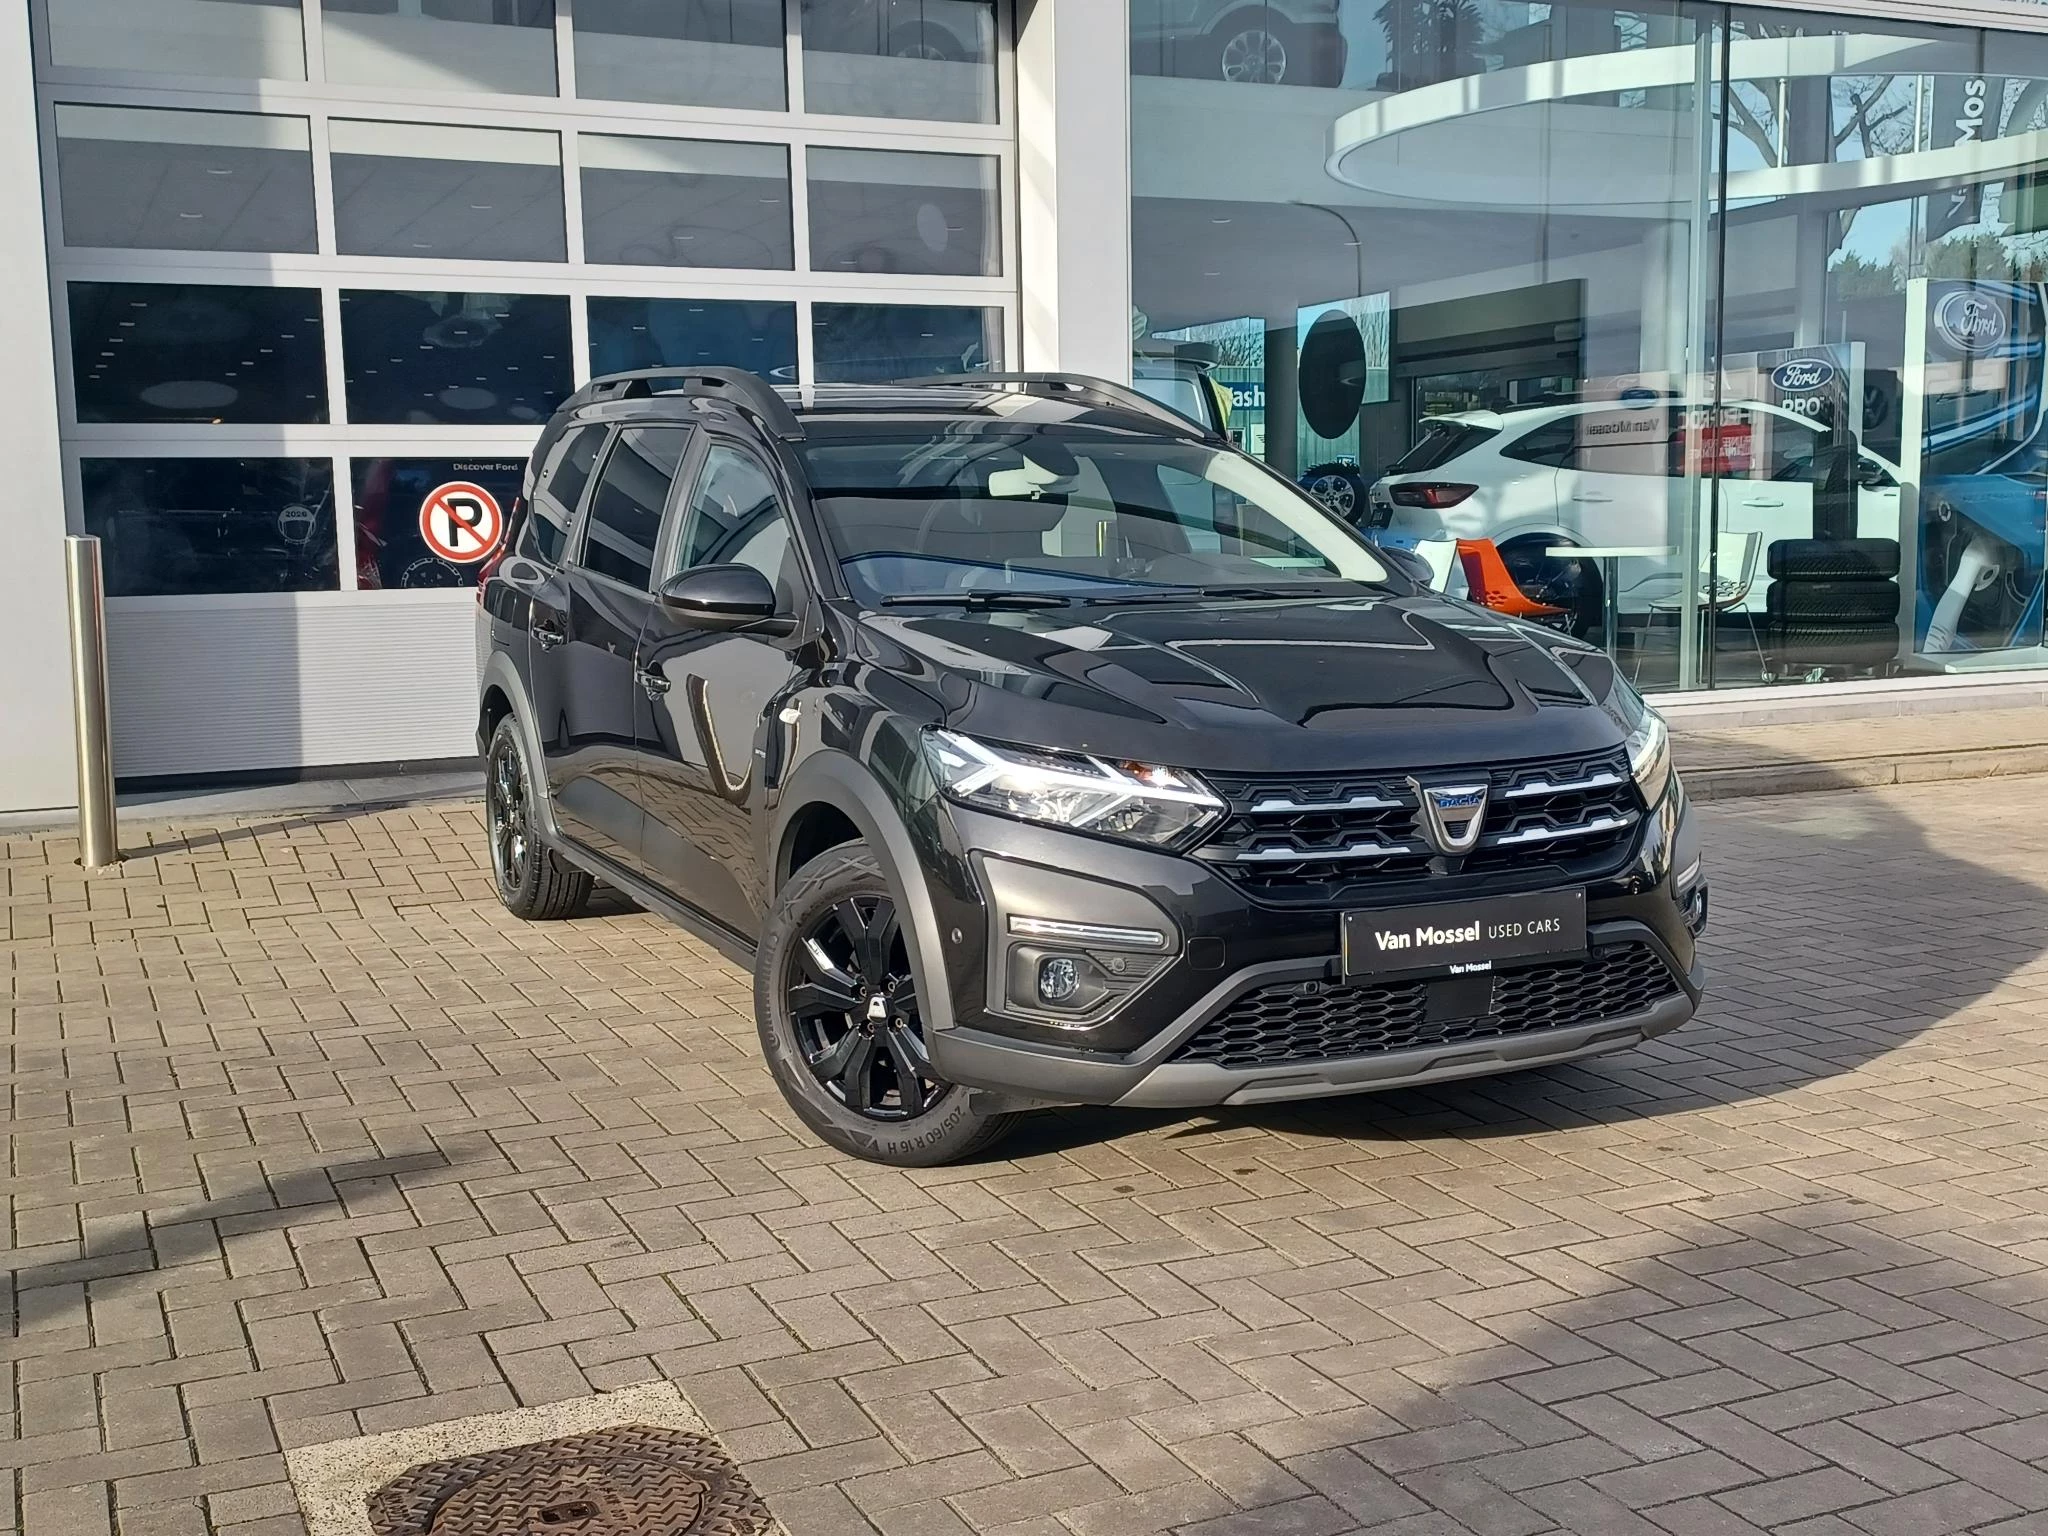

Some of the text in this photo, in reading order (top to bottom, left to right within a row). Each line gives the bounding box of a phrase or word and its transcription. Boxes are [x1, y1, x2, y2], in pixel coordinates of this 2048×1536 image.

[1783, 363, 1822, 386] Ford
[1230, 384, 1265, 407] ash
[453, 463, 518, 471] Discover Ford
[447, 498, 483, 547] P
[1375, 918, 1561, 950] Van Mossel USED CARS
[1450, 960, 1492, 975] Van Mossel
